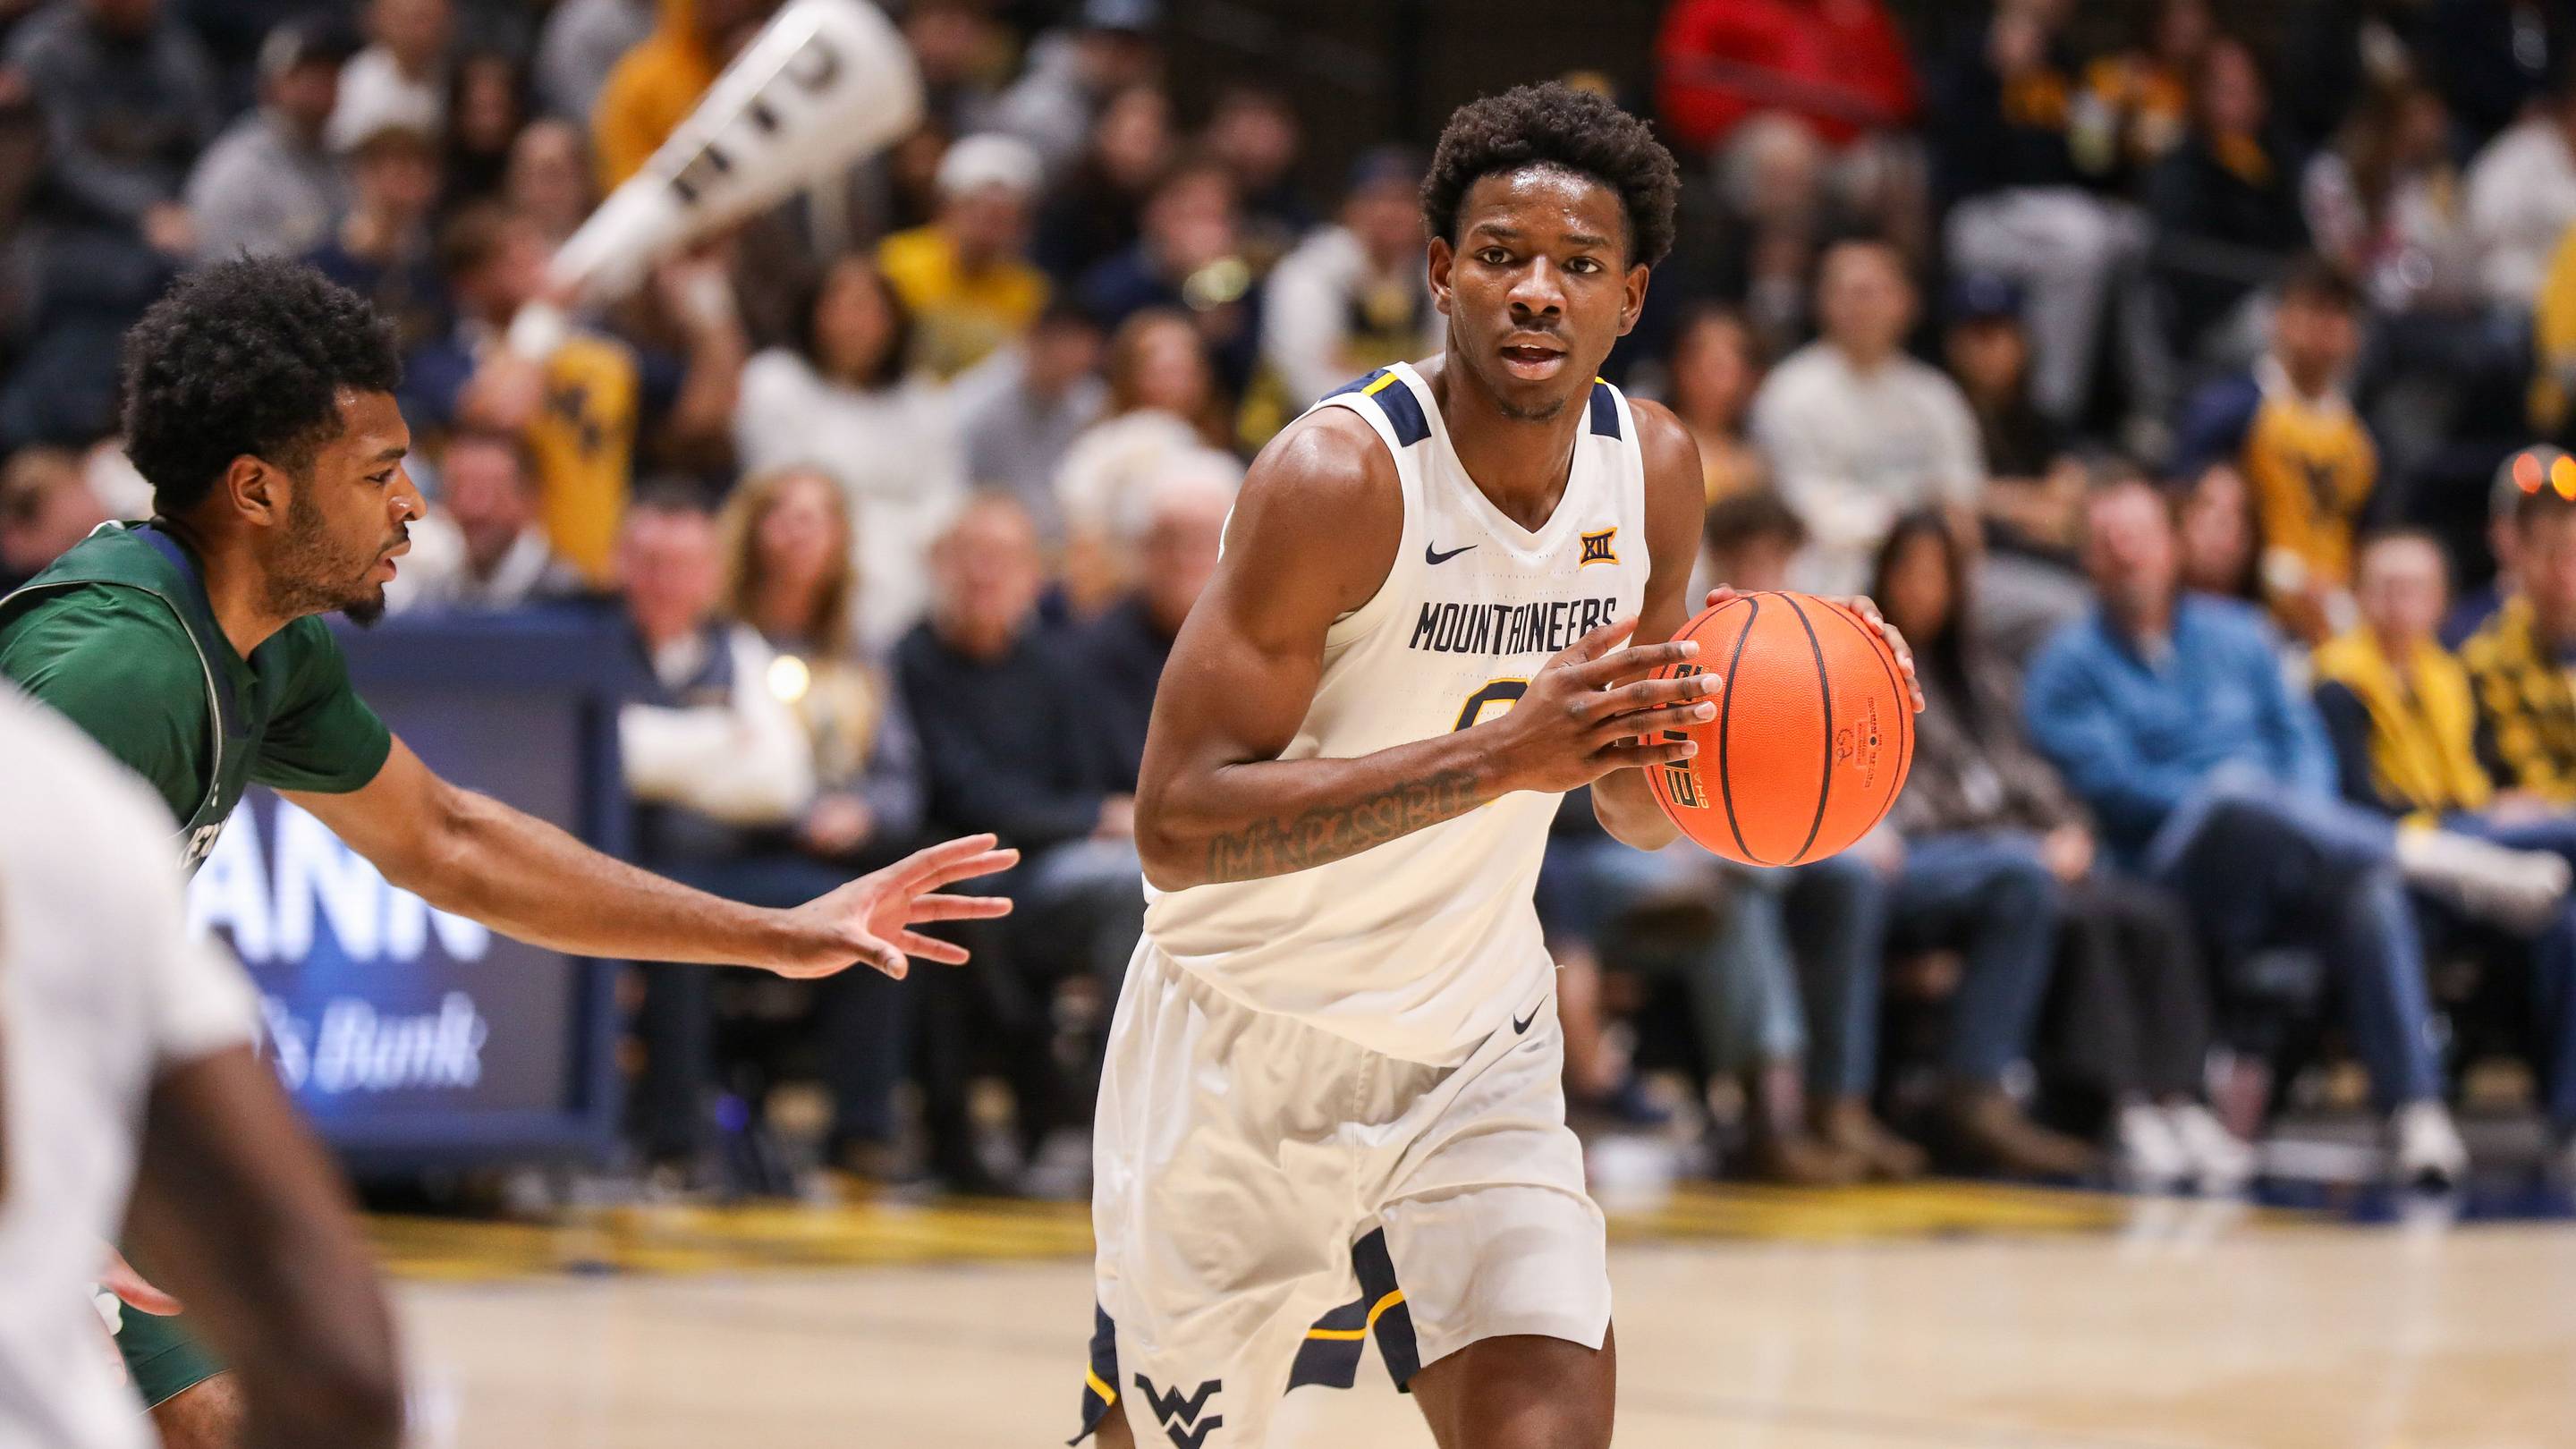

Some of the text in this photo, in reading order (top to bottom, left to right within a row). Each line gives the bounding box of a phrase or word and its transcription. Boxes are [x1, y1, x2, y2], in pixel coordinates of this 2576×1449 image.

[1580, 529, 1616, 565] XII
[1409, 597, 1616, 656] MOUNTAINEERS
[315, 991, 488, 1092] Bank
